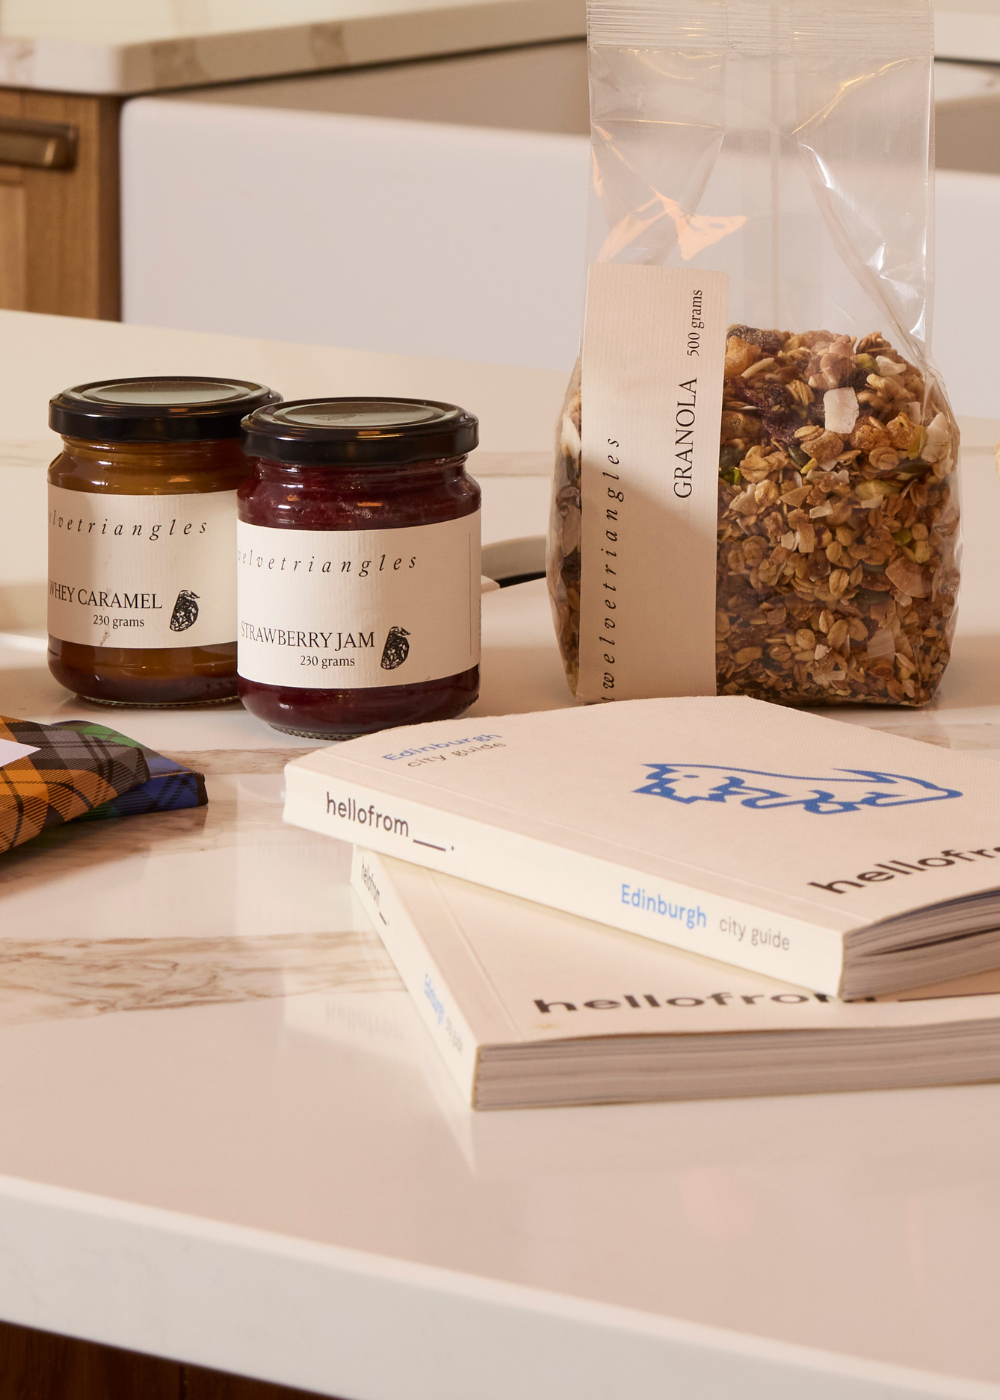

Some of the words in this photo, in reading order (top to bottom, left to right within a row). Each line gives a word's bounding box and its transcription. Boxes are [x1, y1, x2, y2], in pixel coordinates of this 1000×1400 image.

[690, 289, 705, 330] grams
[686, 332, 700, 357] 500
[673, 377, 698, 499] GRANOLA
[49, 509, 207, 541] lvetriangles
[77, 588, 163, 609] CARAMEL
[93, 614, 110, 626] 230
[112, 617, 145, 630] grams
[240, 620, 333, 649] STRAWBERRY
[335, 631, 376, 652] JAM
[300, 655, 319, 667] 230
[321, 657, 356, 670] grams
[382, 733, 502, 761] Edinburgh
[407, 754, 447, 768] city
[451, 742, 507, 757] guide
[326, 791, 409, 837] hellofrom
[621, 883, 707, 930] Edinburgh
[719, 916, 747, 942] city
[751, 927, 790, 951] guide
